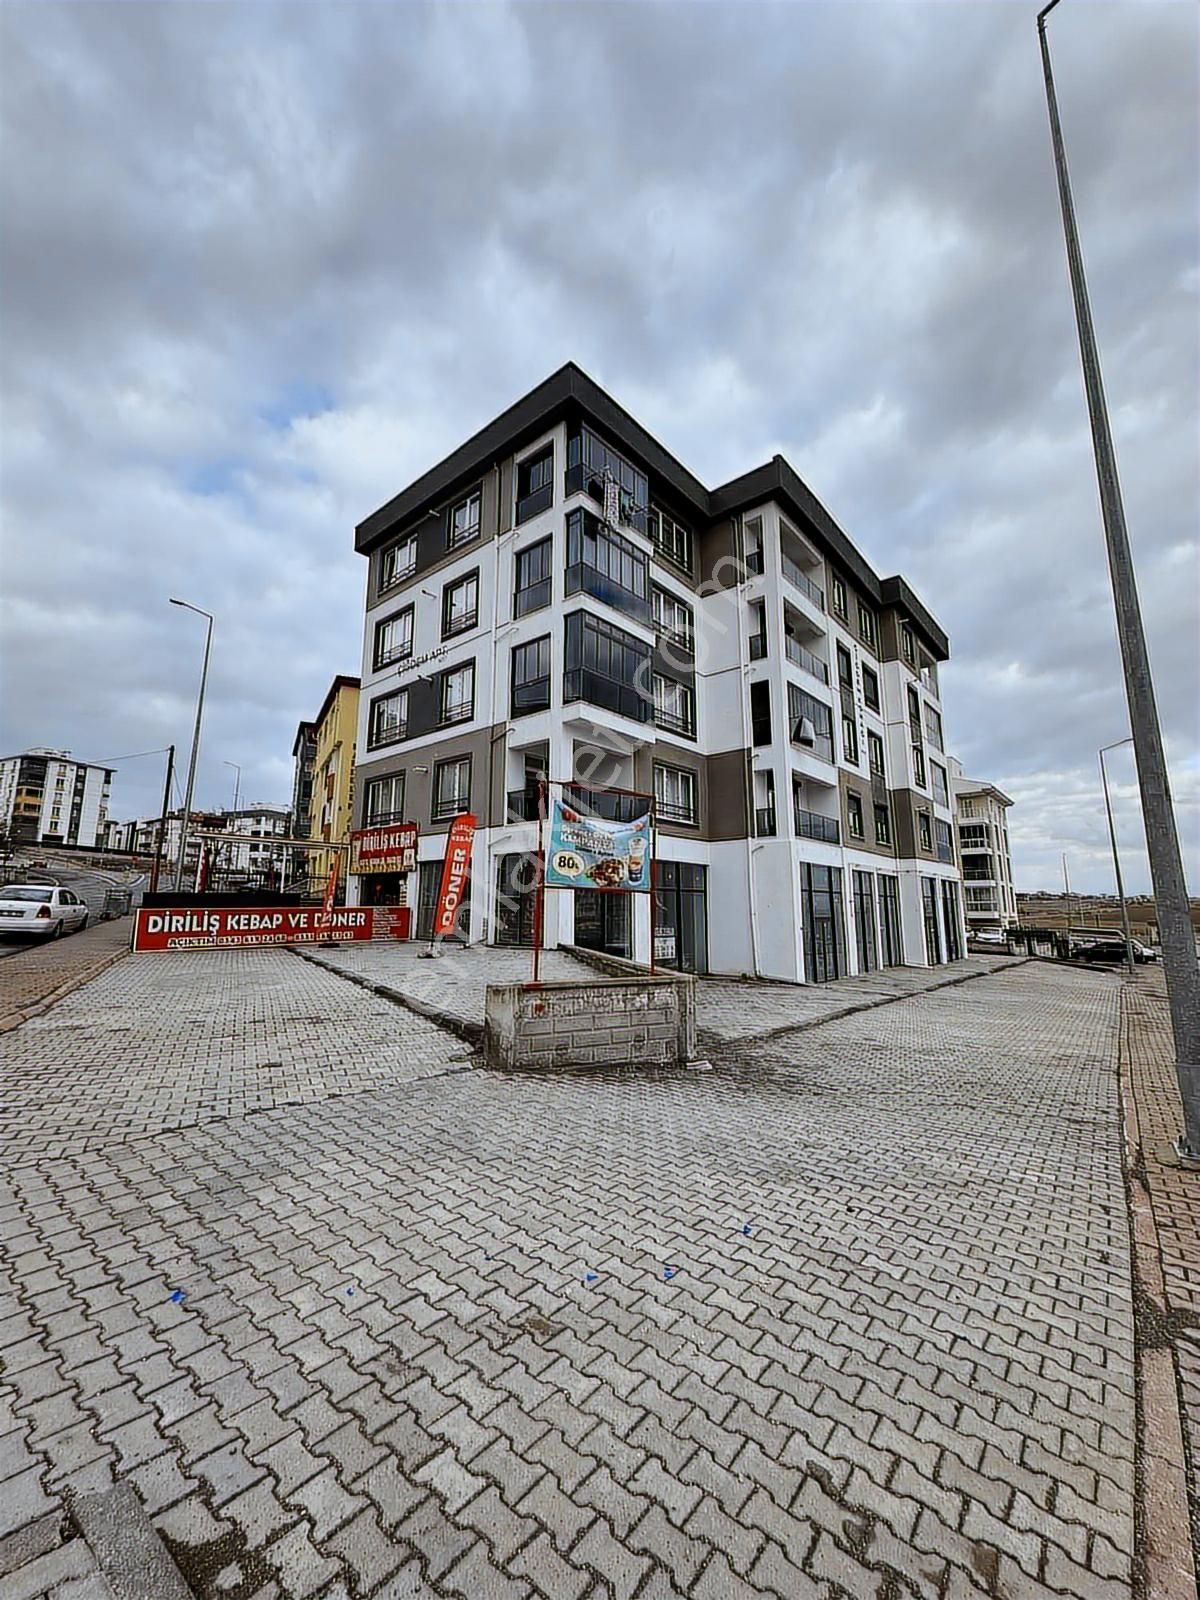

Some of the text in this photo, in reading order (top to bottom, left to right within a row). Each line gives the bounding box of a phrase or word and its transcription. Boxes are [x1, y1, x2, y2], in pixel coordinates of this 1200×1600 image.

[442, 848, 466, 926] DÖNER
[147, 910, 220, 936] DİRİLİŞ
[226, 913, 283, 931] KEBAP
[288, 913, 309, 928] VE
